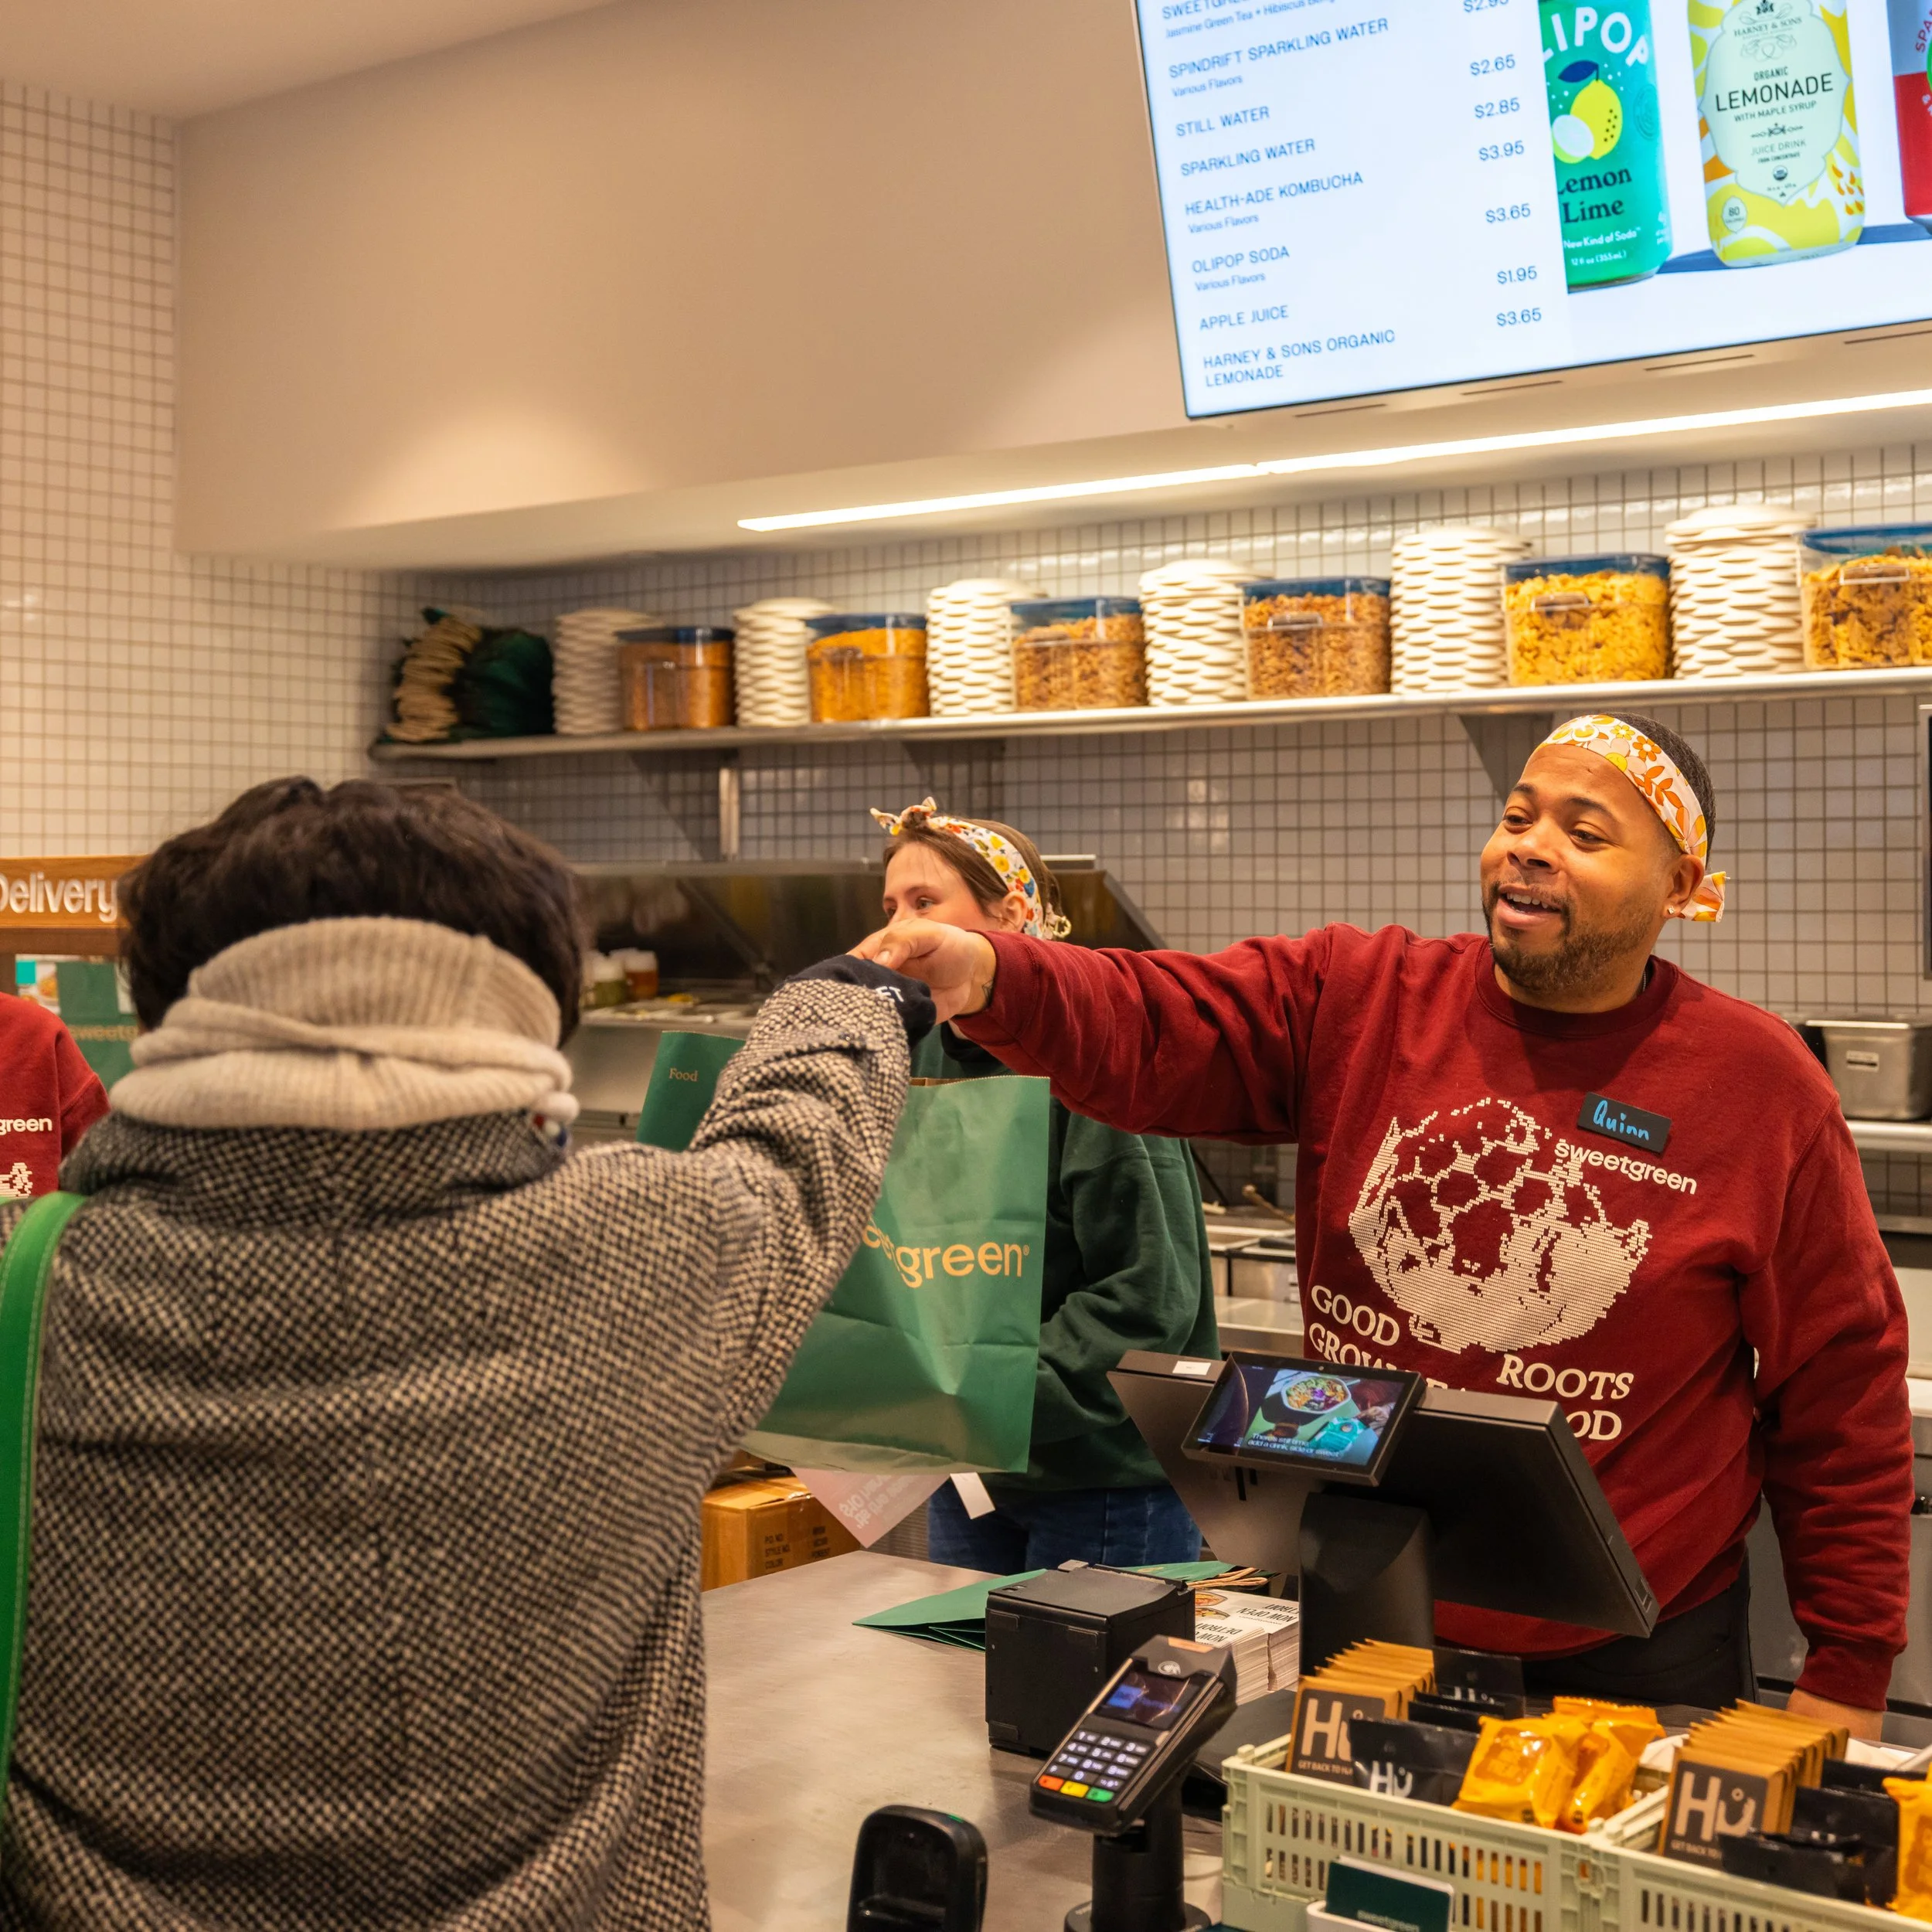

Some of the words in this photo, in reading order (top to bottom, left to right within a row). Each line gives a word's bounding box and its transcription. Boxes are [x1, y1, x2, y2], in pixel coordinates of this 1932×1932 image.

[1166, 22, 1202, 38] Jasmine
[1205, 15, 1234, 29] Green
[1236, 11, 1253, 22] Tea
[1734, 22, 1769, 37] HARNEY
[1781, 17, 1802, 27] SONS
[1915, 8, 1932, 53] SPA
[1168, 50, 1243, 78] SPINDRIFT
[1248, 31, 1332, 61] SPARKLING
[1336, 18, 1389, 41] WATER
[1470, 53, 1515, 76] $2.65
[1754, 66, 1789, 81] ORGANIC
[1172, 83, 1207, 97] Various
[1209, 74, 1243, 90] Flavors
[1716, 73, 1834, 112] LEMONADE
[1474, 97, 1521, 119] $2.85
[1734, 111, 1757, 122] WITH
[1757, 104, 1787, 119] MAPLE
[1789, 100, 1818, 114] SYRUP
[1175, 118, 1216, 137] STILL
[1220, 106, 1270, 128] WATER
[1181, 149, 1261, 176] SPARKLING
[1265, 138, 1316, 159] WATER
[1478, 140, 1525, 162] $3.95
[1751, 143, 1776, 156] JUICE
[1778, 138, 1807, 151] DRINK
[1185, 187, 1274, 216] HEALTH-ADE
[1278, 171, 1363, 199] KOMBUCHA
[1485, 203, 1531, 224] $3.65
[1563, 199, 1624, 223] Lime
[1729, 206, 1740, 217] 80
[1188, 220, 1223, 233] Various
[1224, 214, 1260, 229] Flavors
[1563, 239, 1583, 249] New
[1583, 234, 1604, 247] Kind
[1604, 233, 1614, 243] of
[1192, 253, 1244, 274] OLIPOP
[1249, 246, 1290, 264] SODA
[1195, 278, 1230, 291] Various
[1231, 272, 1266, 286] Flavors
[1497, 265, 1538, 284] $1.95
[1199, 311, 1245, 331] APPLE
[1250, 304, 1289, 324] JUICE
[1496, 307, 1542, 327] $3.65
[1203, 349, 1261, 369] HARNEY
[1267, 346, 1277, 361] &
[1281, 340, 1322, 359] SONS
[1327, 329, 1396, 352] ORGANIC
[1206, 364, 1284, 387] LEMONADE
[668, 1067, 699, 1082] Food
[1594, 1100, 1650, 1141] Quinn
[1554, 1141, 1697, 1195] sweetgreen
[1311, 1284, 1400, 1346] GOOD
[1496, 1353, 1634, 1400] ROOTS
[1236, 1607, 1270, 1617] OPEN
[1264, 1604, 1299, 1614] TROIT
[1267, 1612, 1298, 1623] NOW
[1196, 1623, 1243, 1635] DETROIT
[1198, 1632, 1228, 1643] NOW
